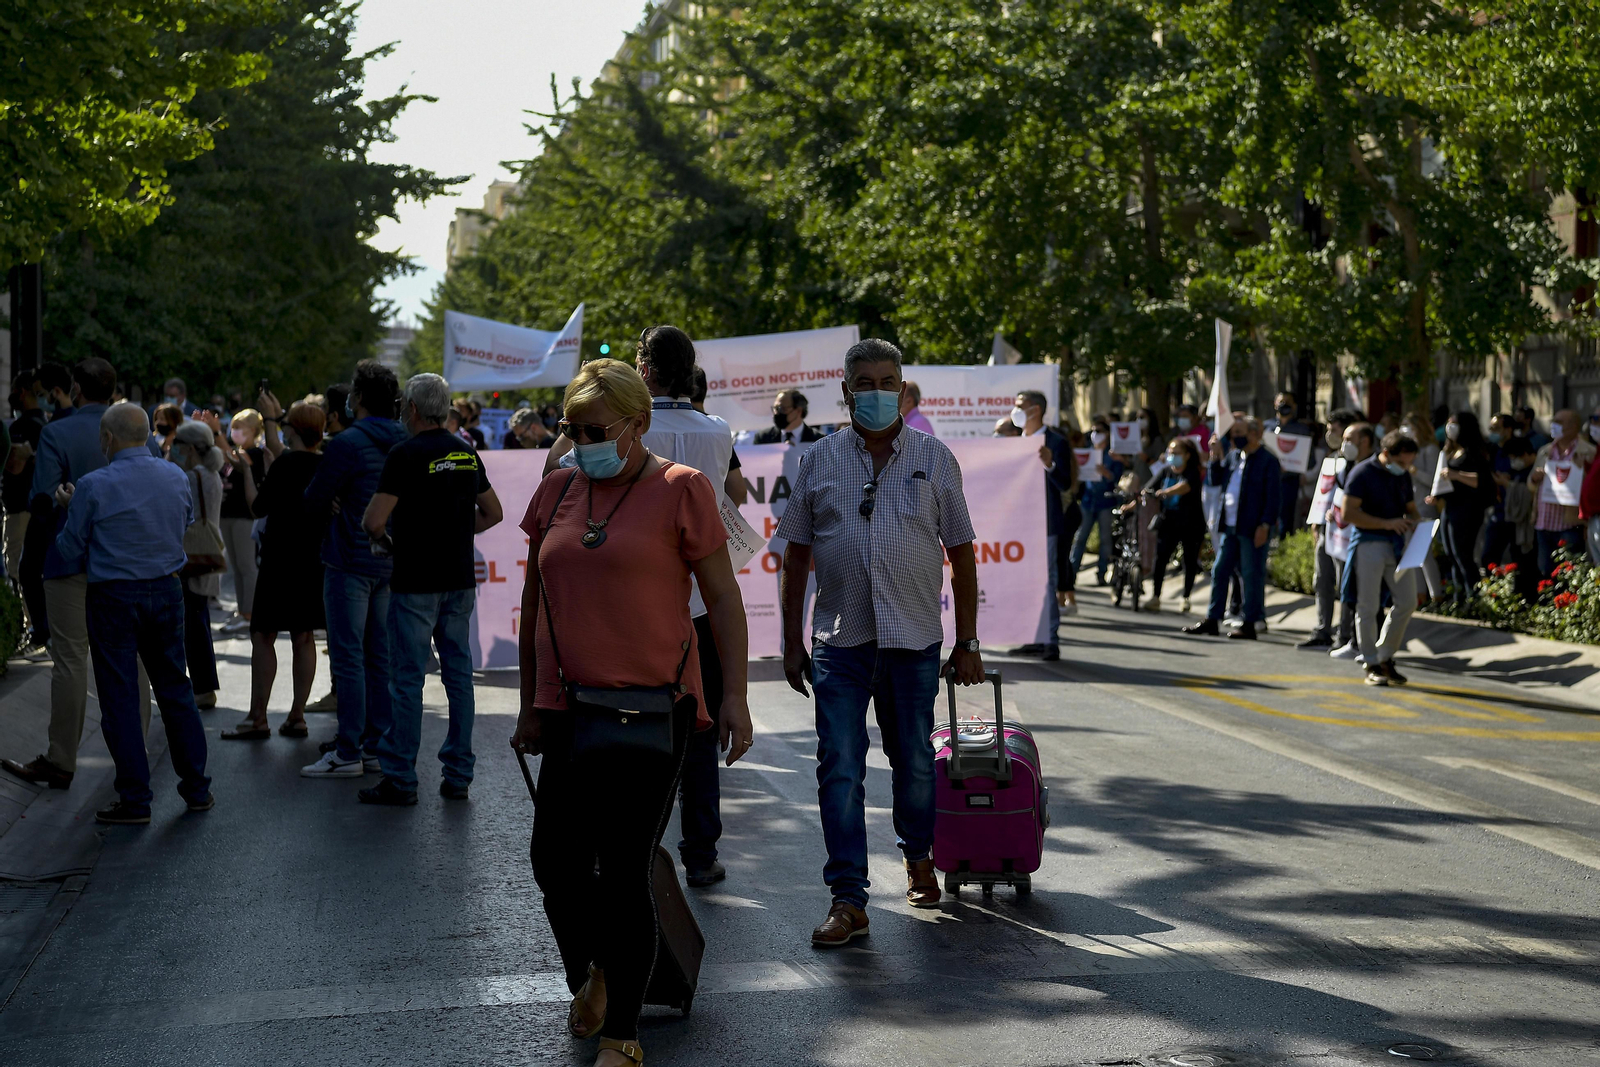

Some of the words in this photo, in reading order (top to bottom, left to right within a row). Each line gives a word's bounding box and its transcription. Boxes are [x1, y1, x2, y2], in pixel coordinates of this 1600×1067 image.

[454, 345, 493, 365] SOMOS
[496, 354, 525, 370] OCIO
[707, 380, 727, 390] OS
[731, 375, 765, 388] OCIO
[769, 368, 845, 384] NOCTURNO
[918, 397, 955, 407] OMOS
[959, 397, 974, 406] EL
[742, 476, 792, 505] NA
[726, 509, 735, 521] LOS
[733, 521, 745, 535] POR
[728, 536, 737, 546] TU
[734, 533, 748, 548] OCIO
[746, 546, 755, 554] EL
[474, 561, 507, 583] EL
